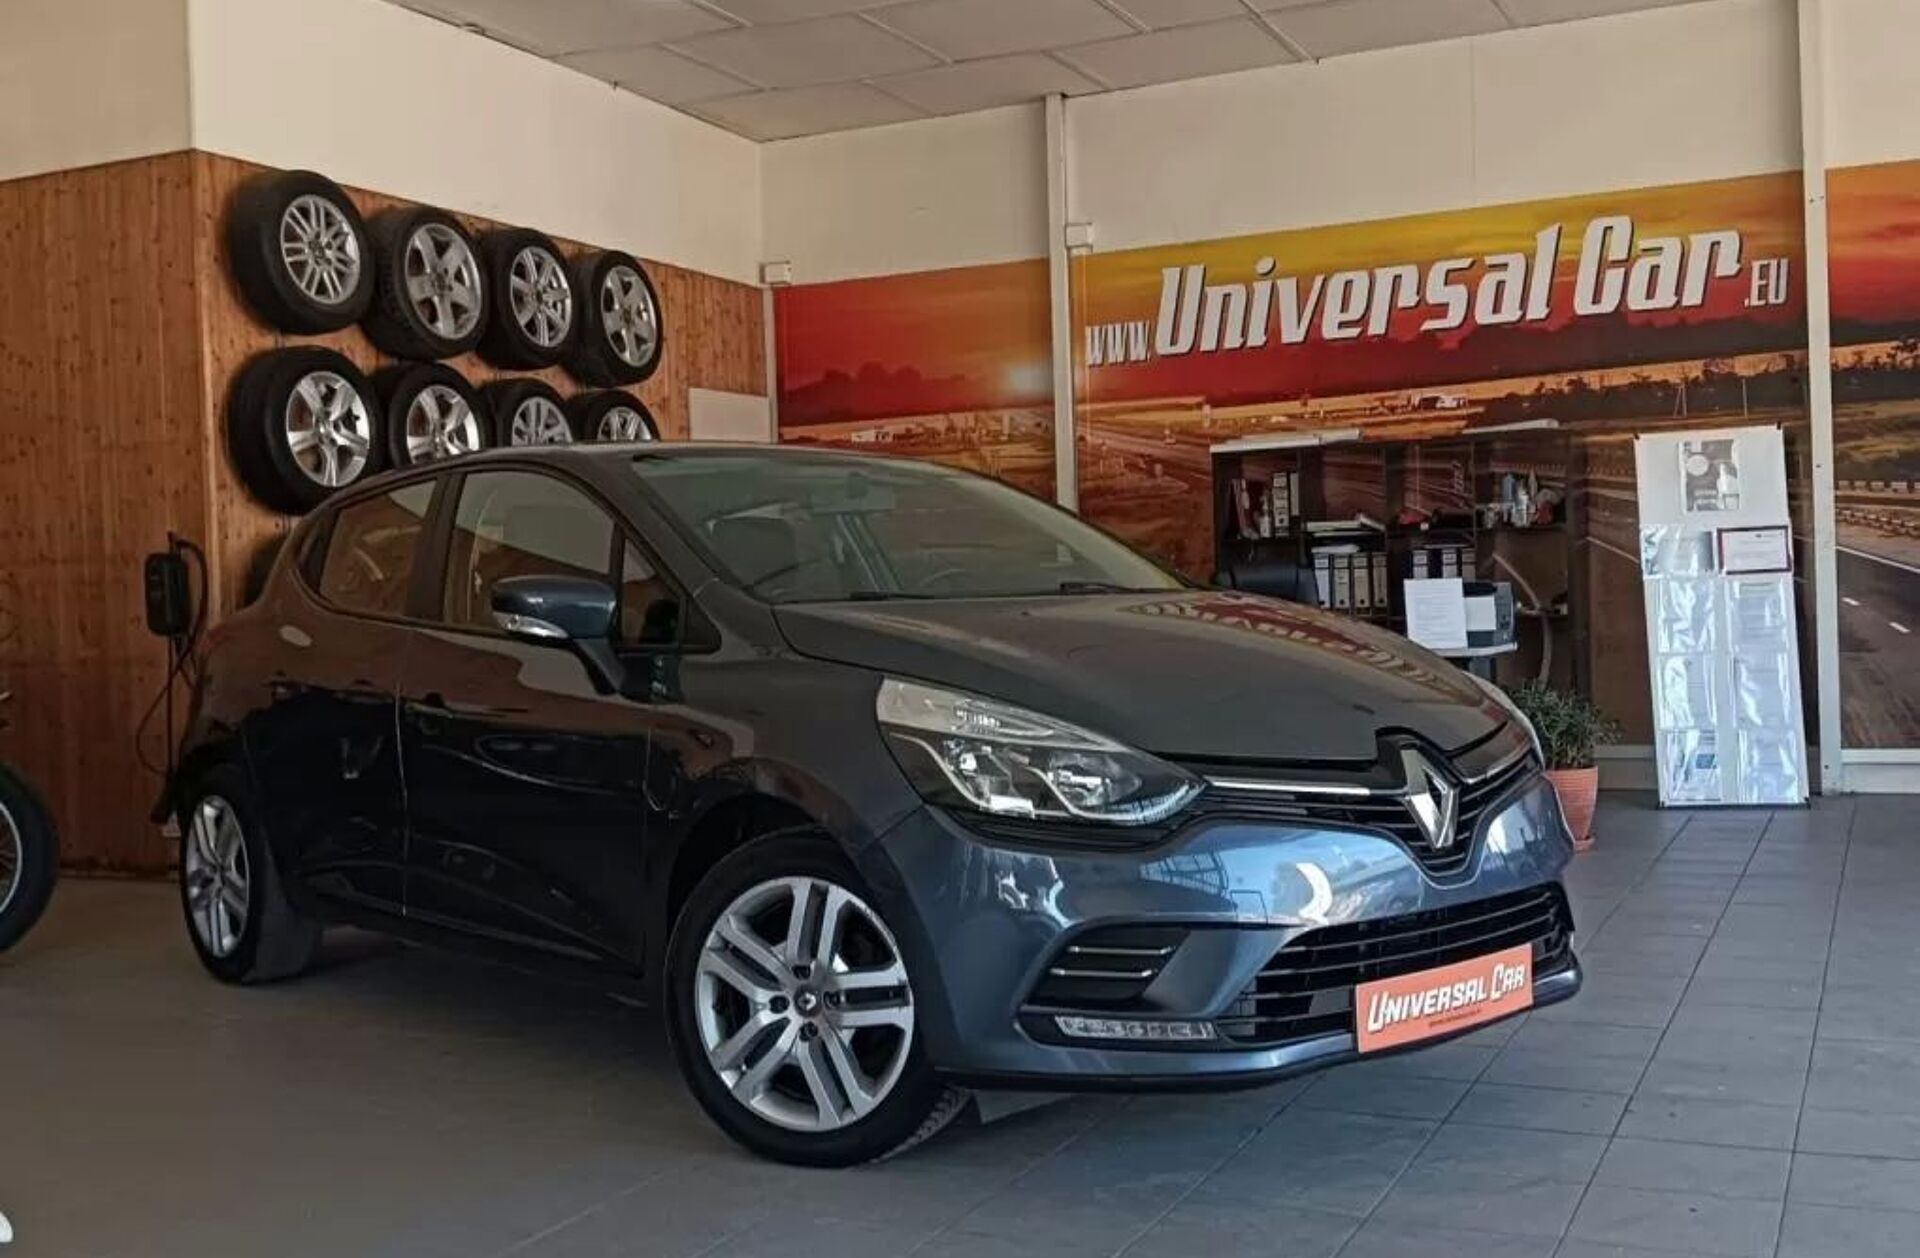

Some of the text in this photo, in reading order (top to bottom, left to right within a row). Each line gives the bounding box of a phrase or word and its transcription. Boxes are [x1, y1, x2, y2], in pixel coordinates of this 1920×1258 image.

[1155, 223, 1561, 355] Universal
[1574, 215, 1742, 316] Car
[1367, 975, 1487, 1033] UNIVERSAL
